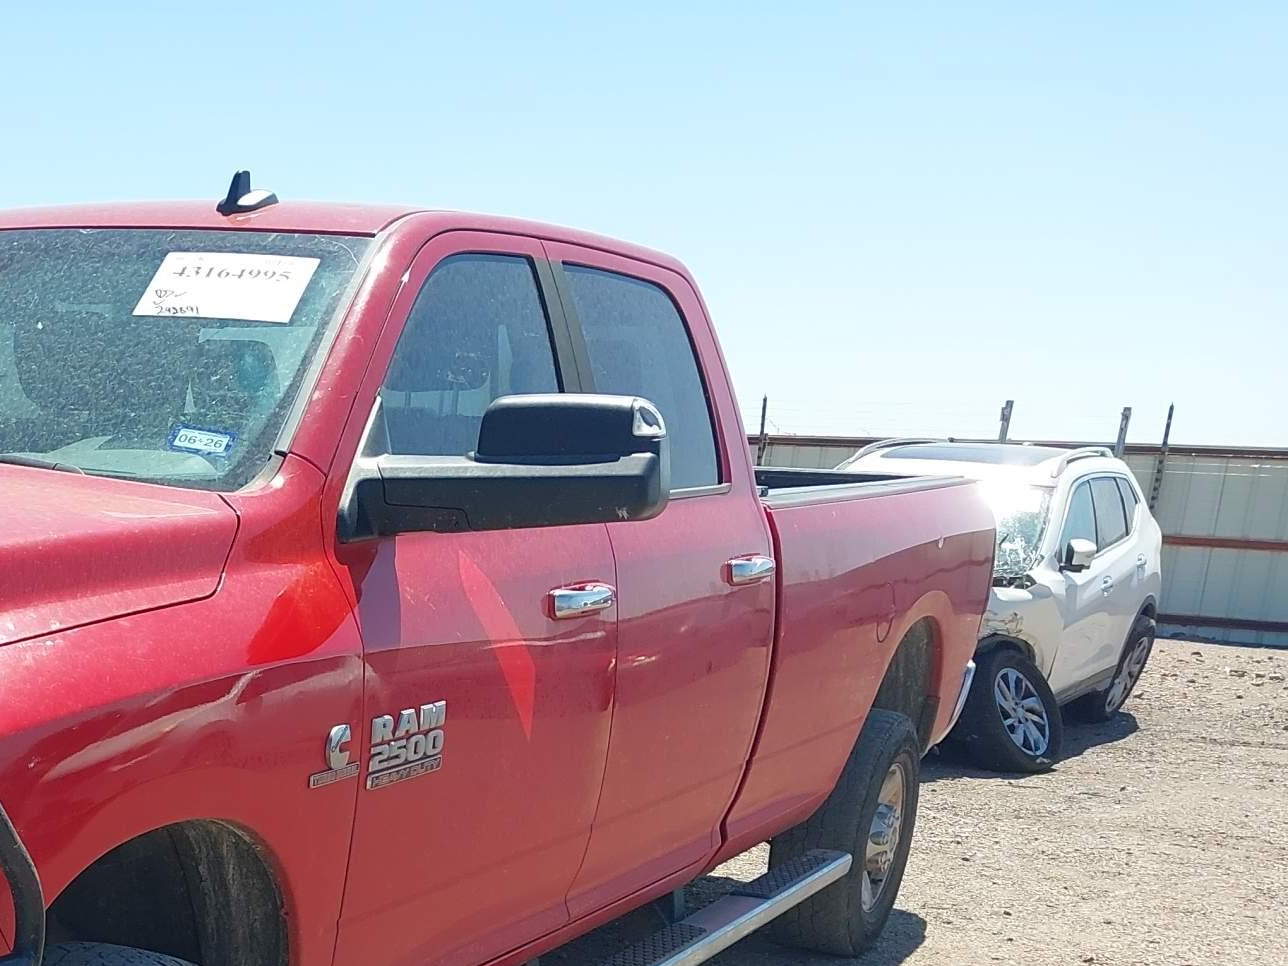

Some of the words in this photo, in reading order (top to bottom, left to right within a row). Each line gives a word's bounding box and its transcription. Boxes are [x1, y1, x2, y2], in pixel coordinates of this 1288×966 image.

[172, 265, 293, 282] 43164995
[370, 700, 447, 745] RAM
[369, 729, 445, 773] 2500
